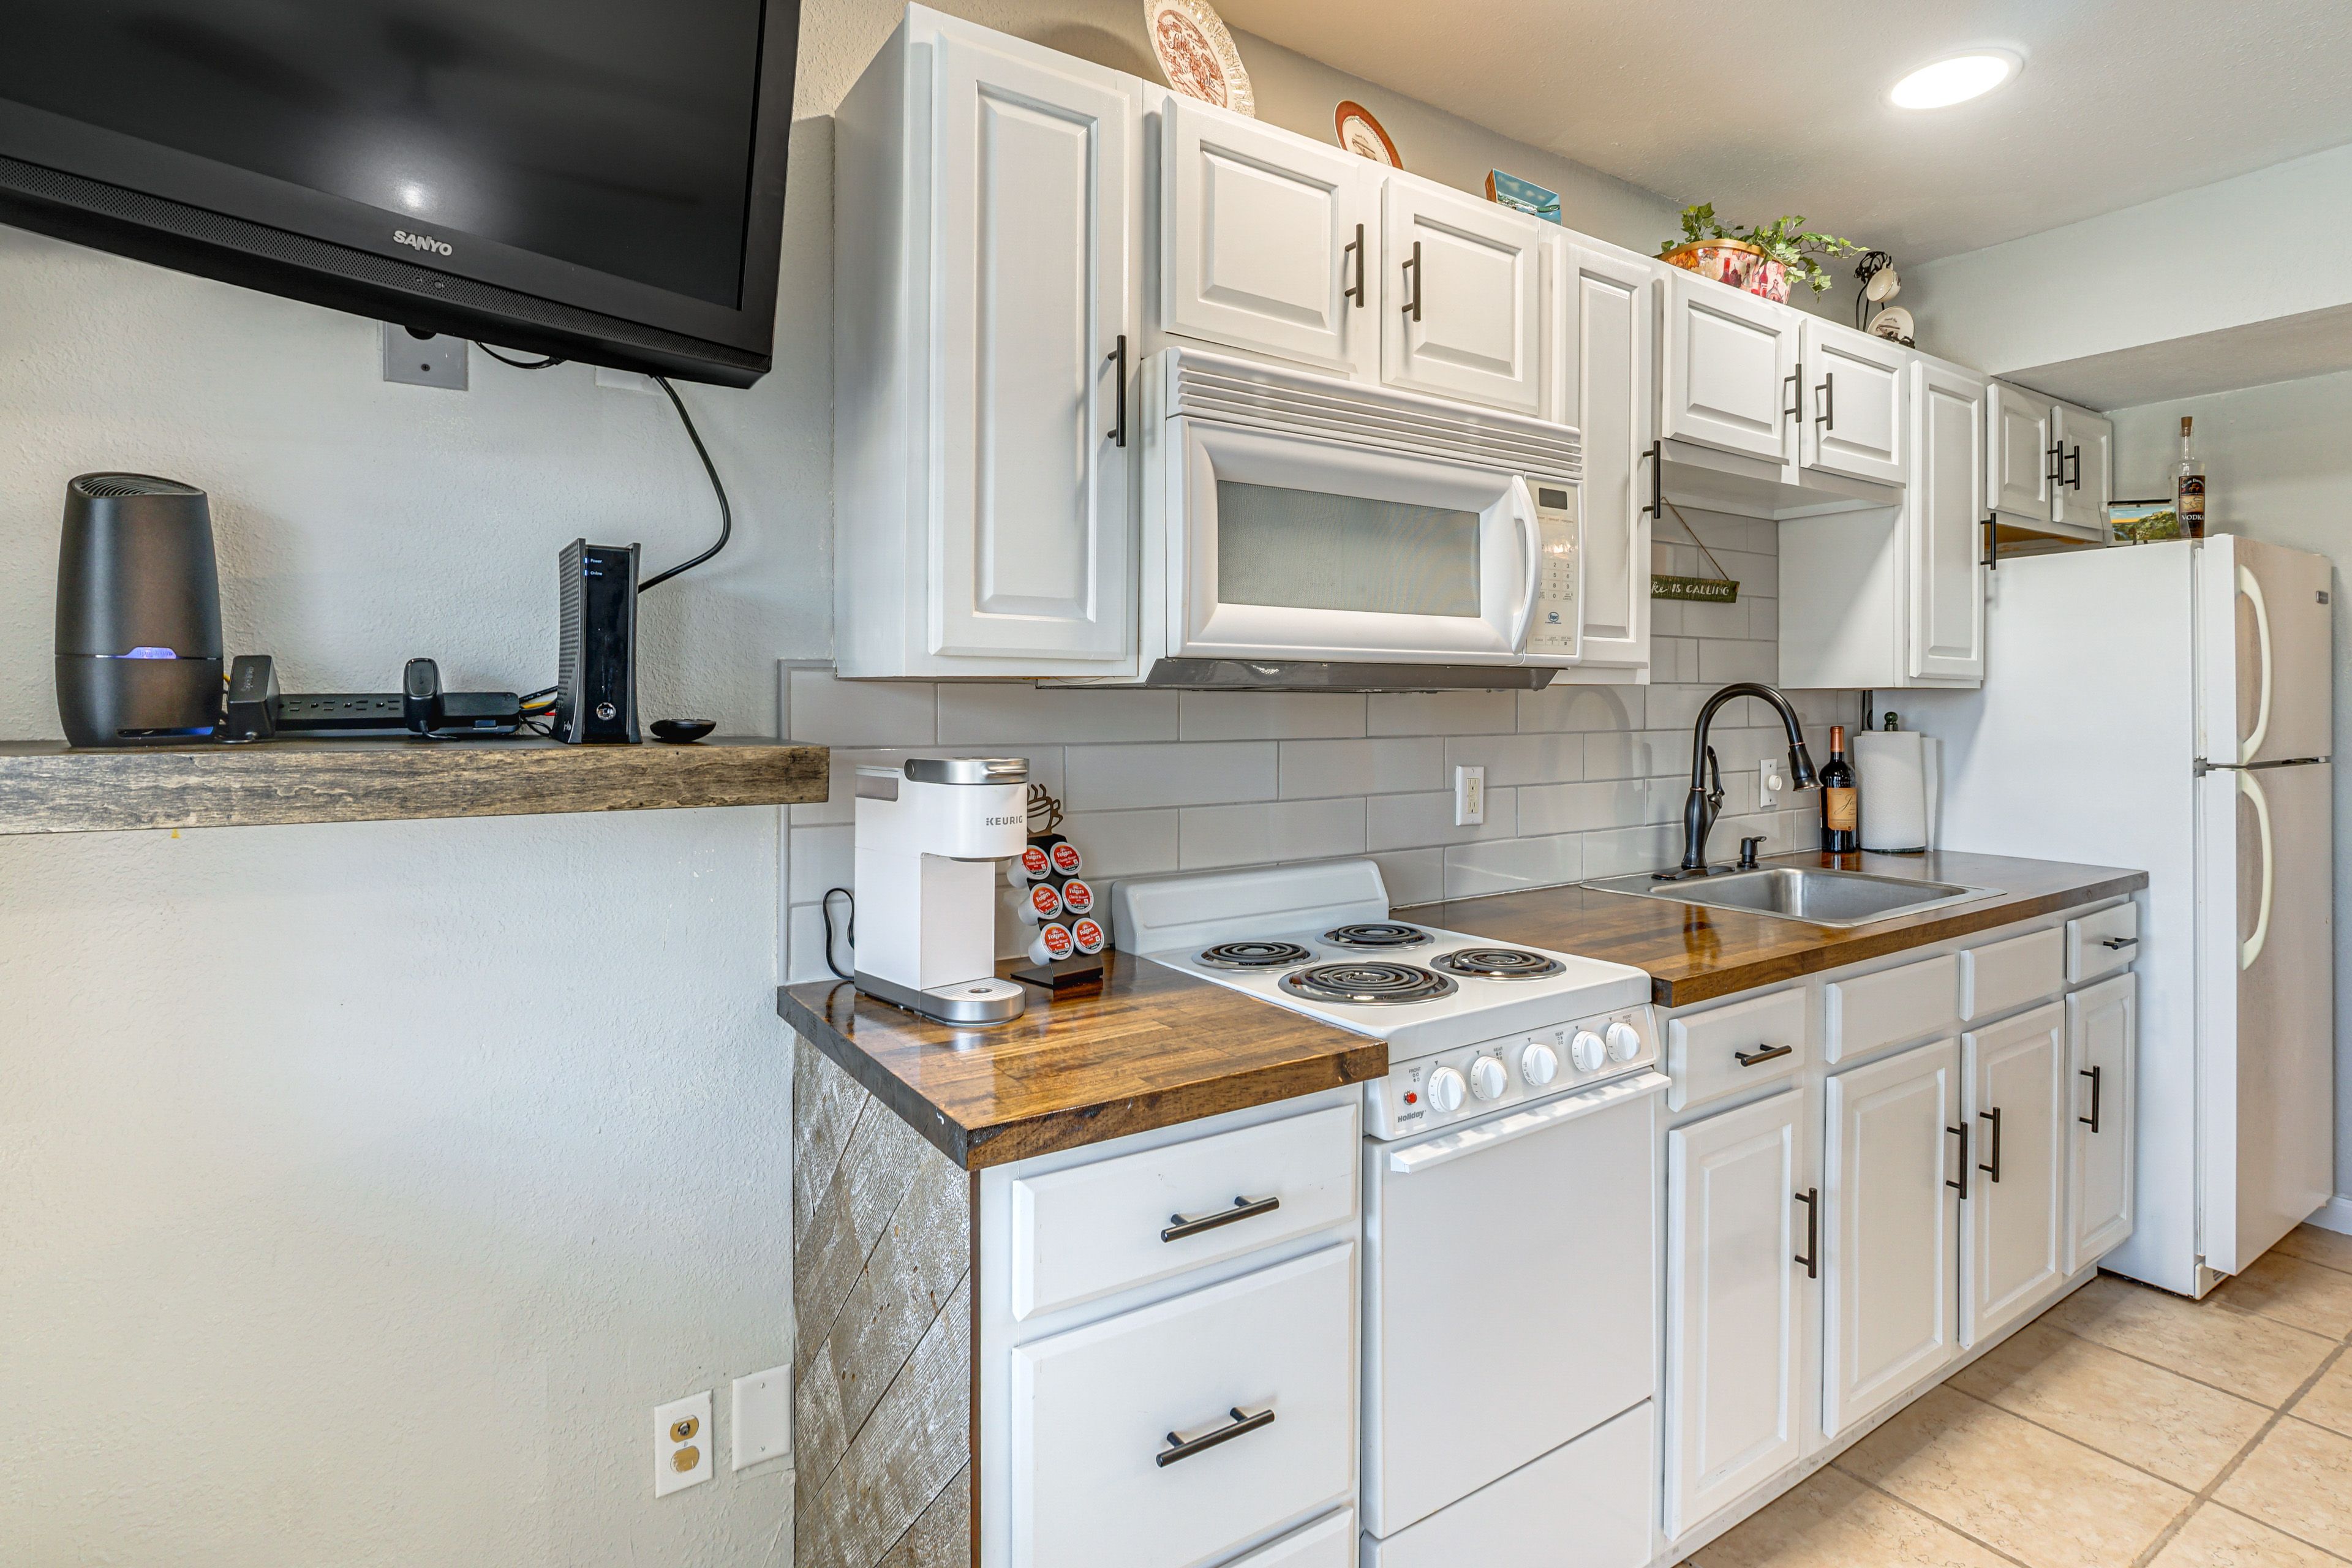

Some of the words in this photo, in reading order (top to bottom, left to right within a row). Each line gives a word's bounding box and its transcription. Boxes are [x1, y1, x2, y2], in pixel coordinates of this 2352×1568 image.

[393, 230, 453, 256] SANYO
[1672, 584, 1681, 593] IS
[1686, 584, 1729, 595] CALLING
[986, 815, 1023, 826] KEURIG
[1036, 892, 1050, 902] Folgers
[1079, 927, 1095, 935] Folgers
[1397, 1110, 1424, 1123] Holiday
